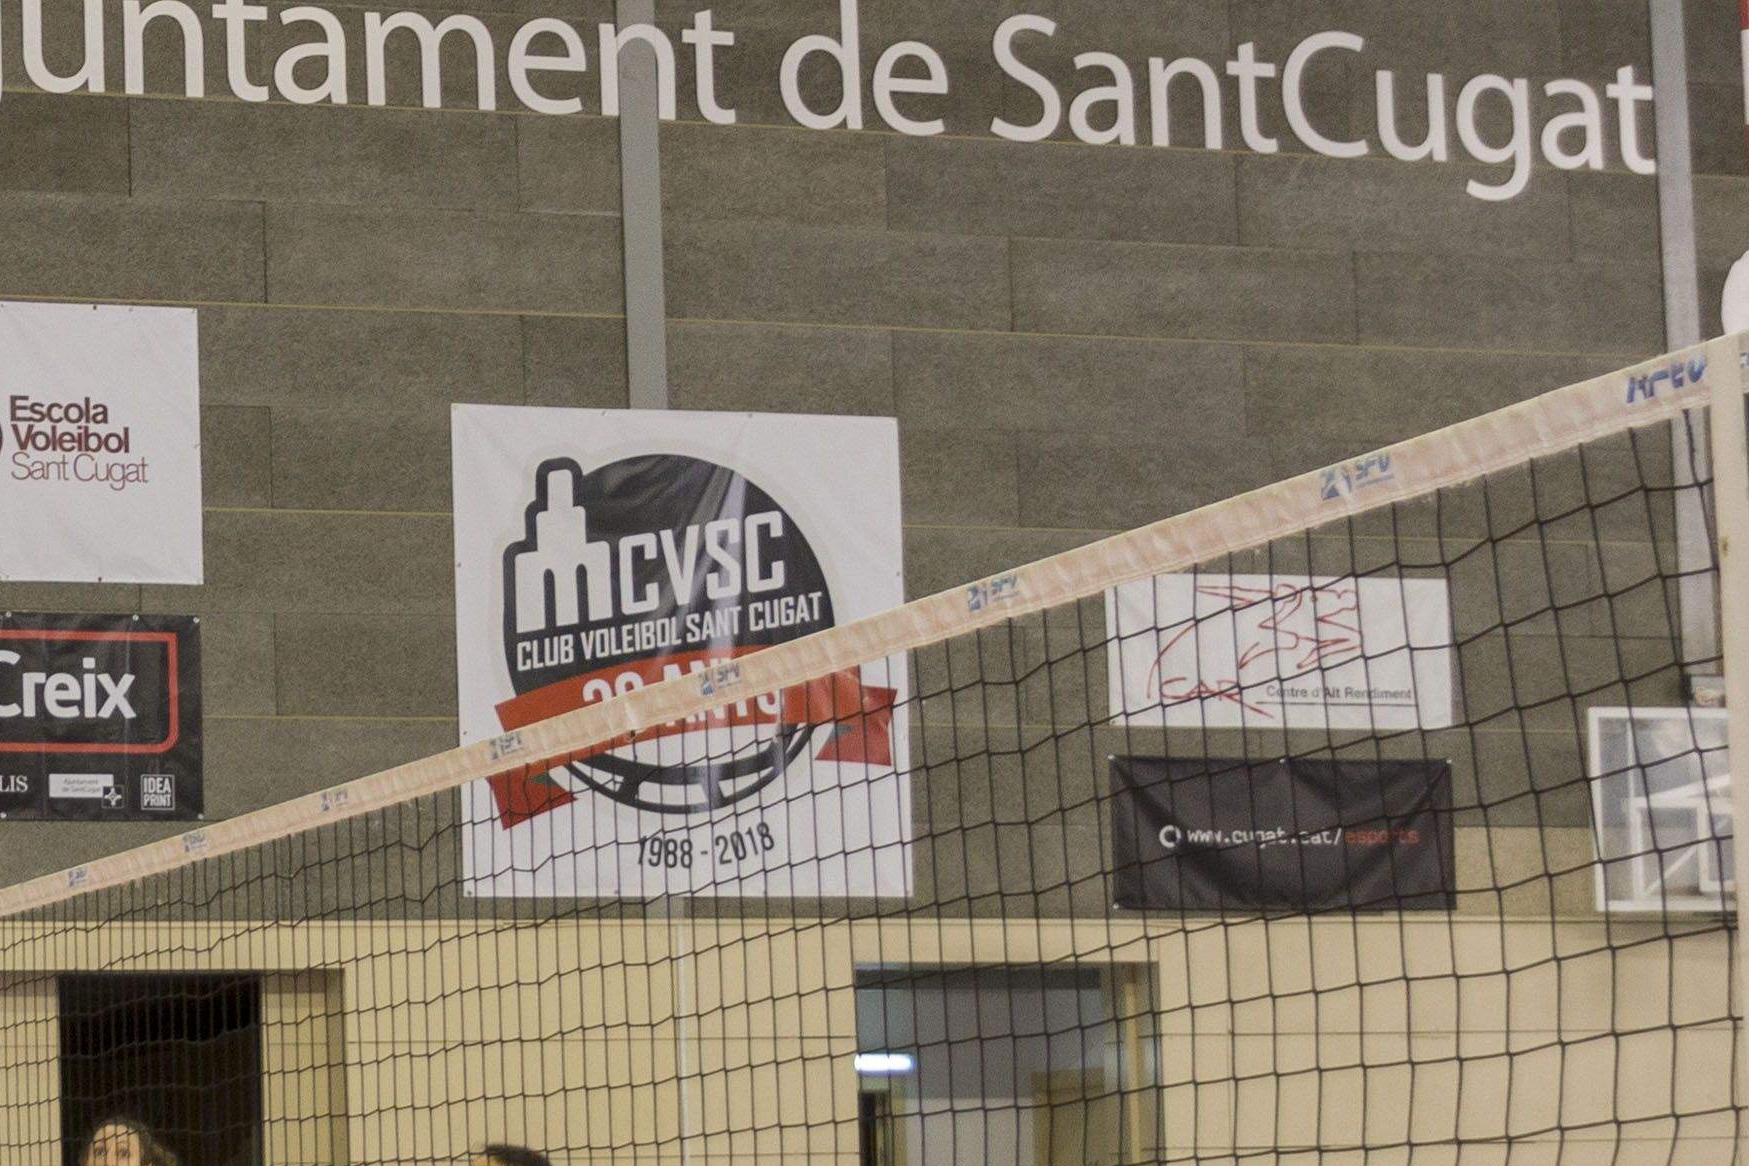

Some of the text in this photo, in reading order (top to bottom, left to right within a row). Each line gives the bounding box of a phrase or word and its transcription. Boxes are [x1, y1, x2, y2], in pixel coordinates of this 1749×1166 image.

[779, 0, 949, 136] de
[990, 14, 1658, 201] SantCugat
[10, 395, 108, 424] Escola
[11, 424, 130, 453] Voleibol
[11, 451, 149, 491] Sant Cugat
[618, 511, 784, 615] CVSC
[517, 592, 823, 672] CLUB VOLEIBOL SANT CUGAT
[143, 795, 172, 807] PRINT
[144, 777, 172, 793] IDEA
[637, 834, 693, 868] 1988
[715, 822, 776, 866] 2018
